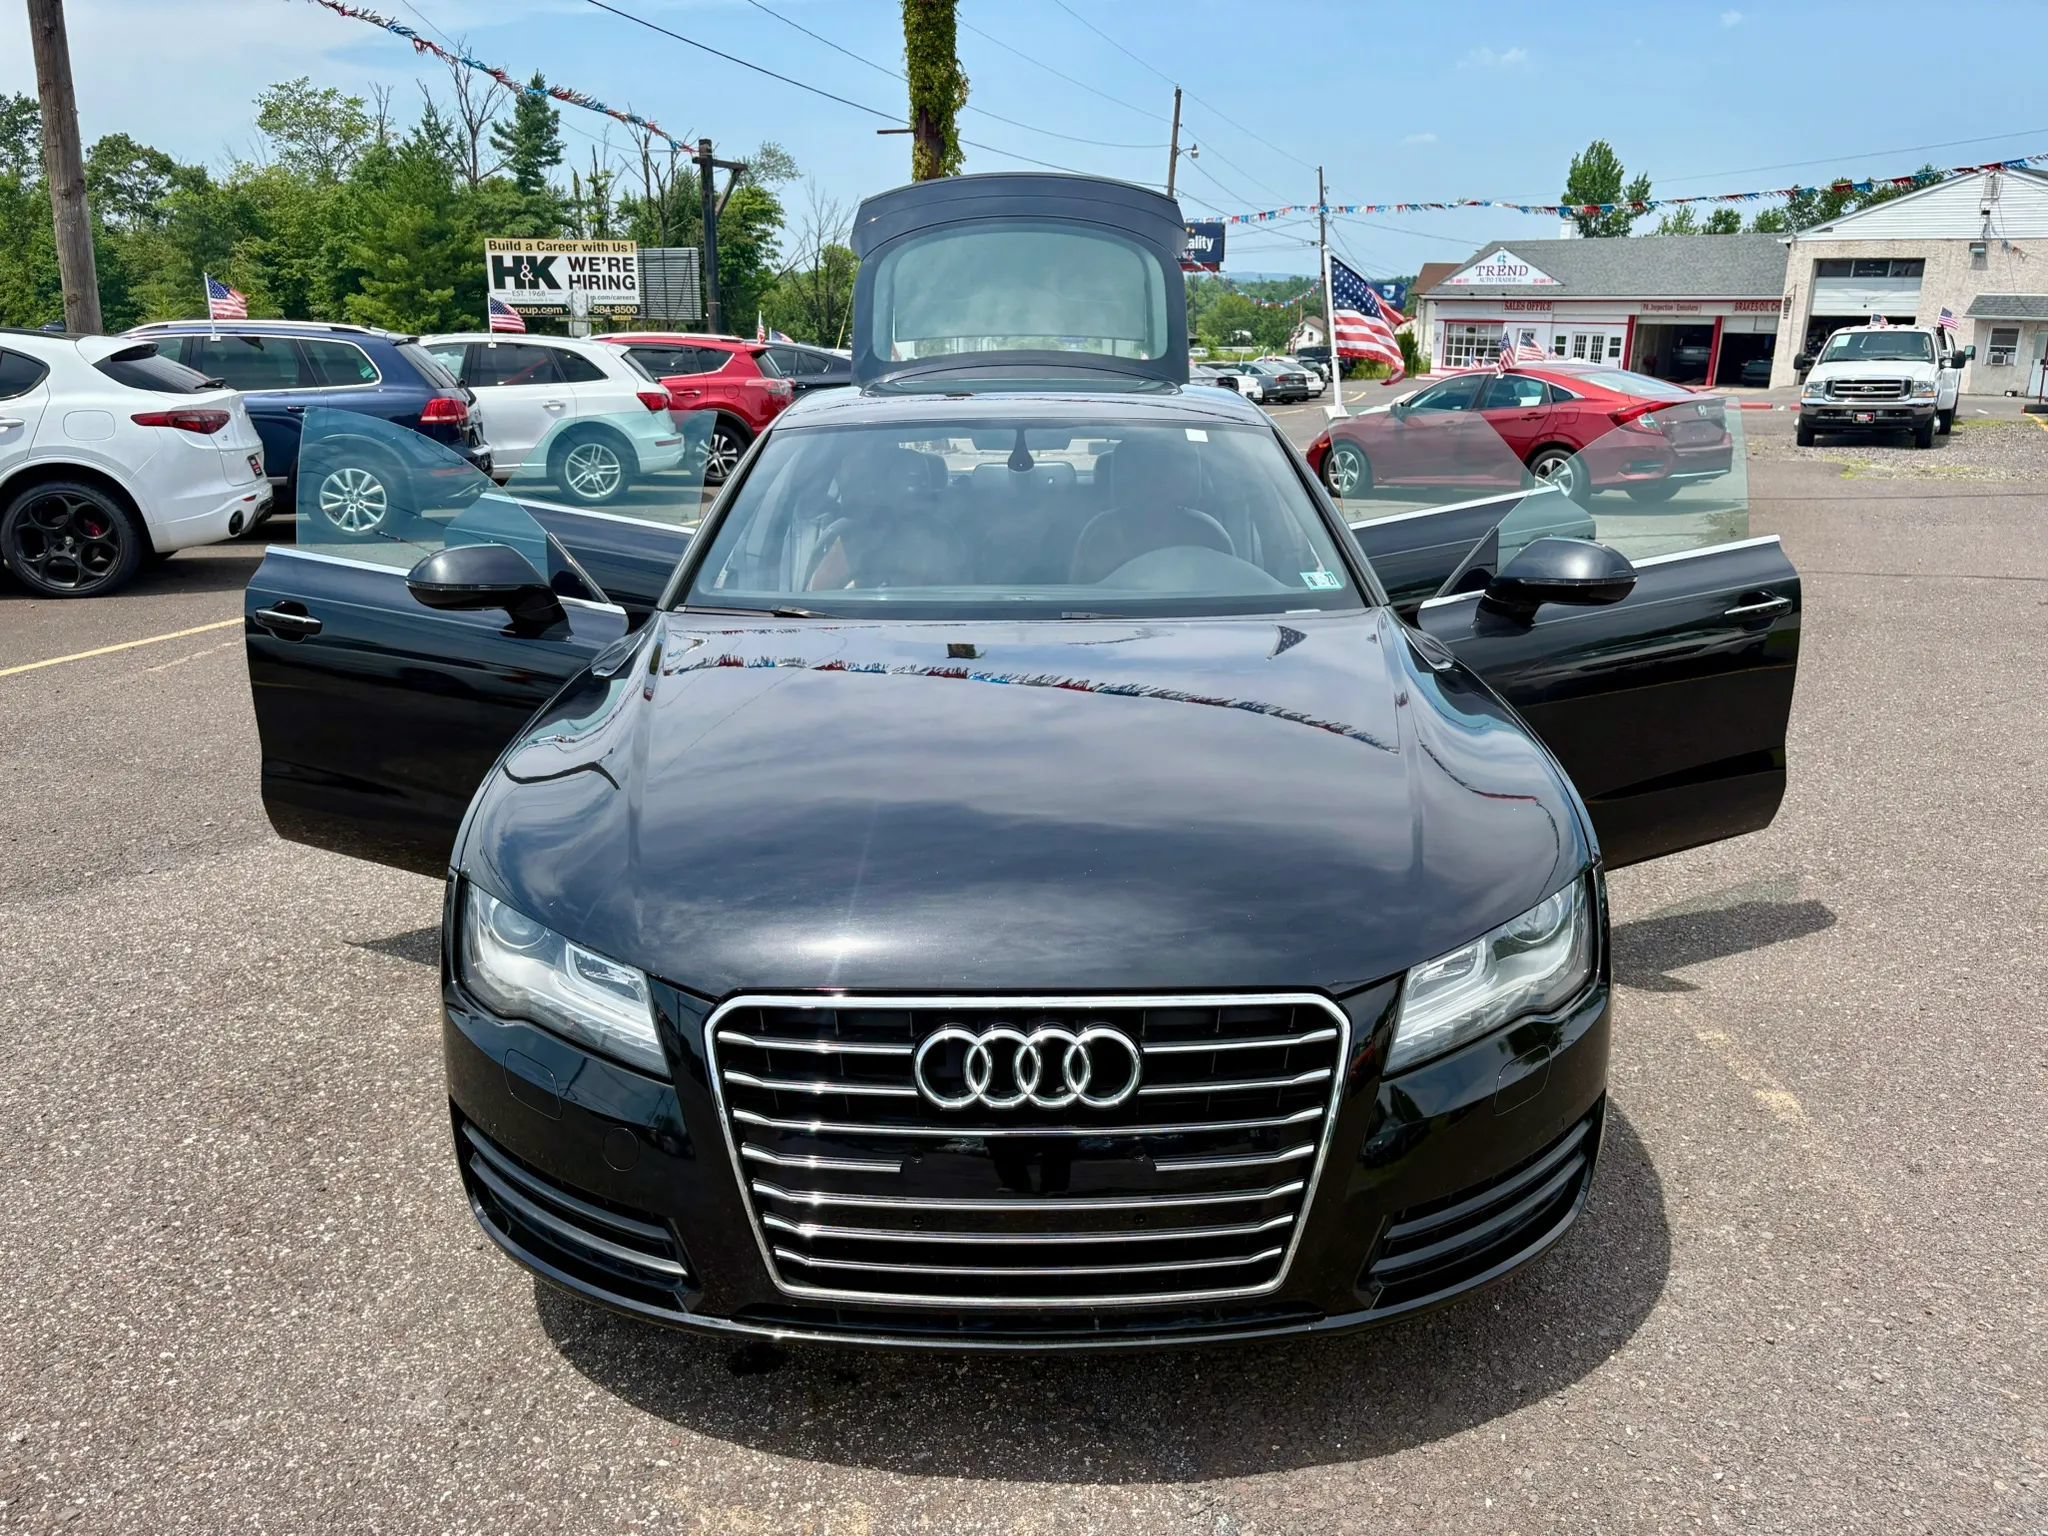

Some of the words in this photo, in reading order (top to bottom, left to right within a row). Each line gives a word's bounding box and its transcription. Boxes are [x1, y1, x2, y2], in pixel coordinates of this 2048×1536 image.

[489, 240, 521, 251] Build
[525, 243, 532, 251] a
[536, 241, 577, 252] Career
[583, 242, 609, 252] with
[567, 256, 635, 273] WE'RE
[491, 255, 563, 290] H&K
[1475, 265, 1529, 276] TREND
[568, 274, 636, 291] HIRING
[514, 305, 563, 315] roup.com
[1504, 301, 1525, 311] SALES
[1526, 301, 1552, 311] OFFICE
[1734, 302, 1758, 312] BRAKES
